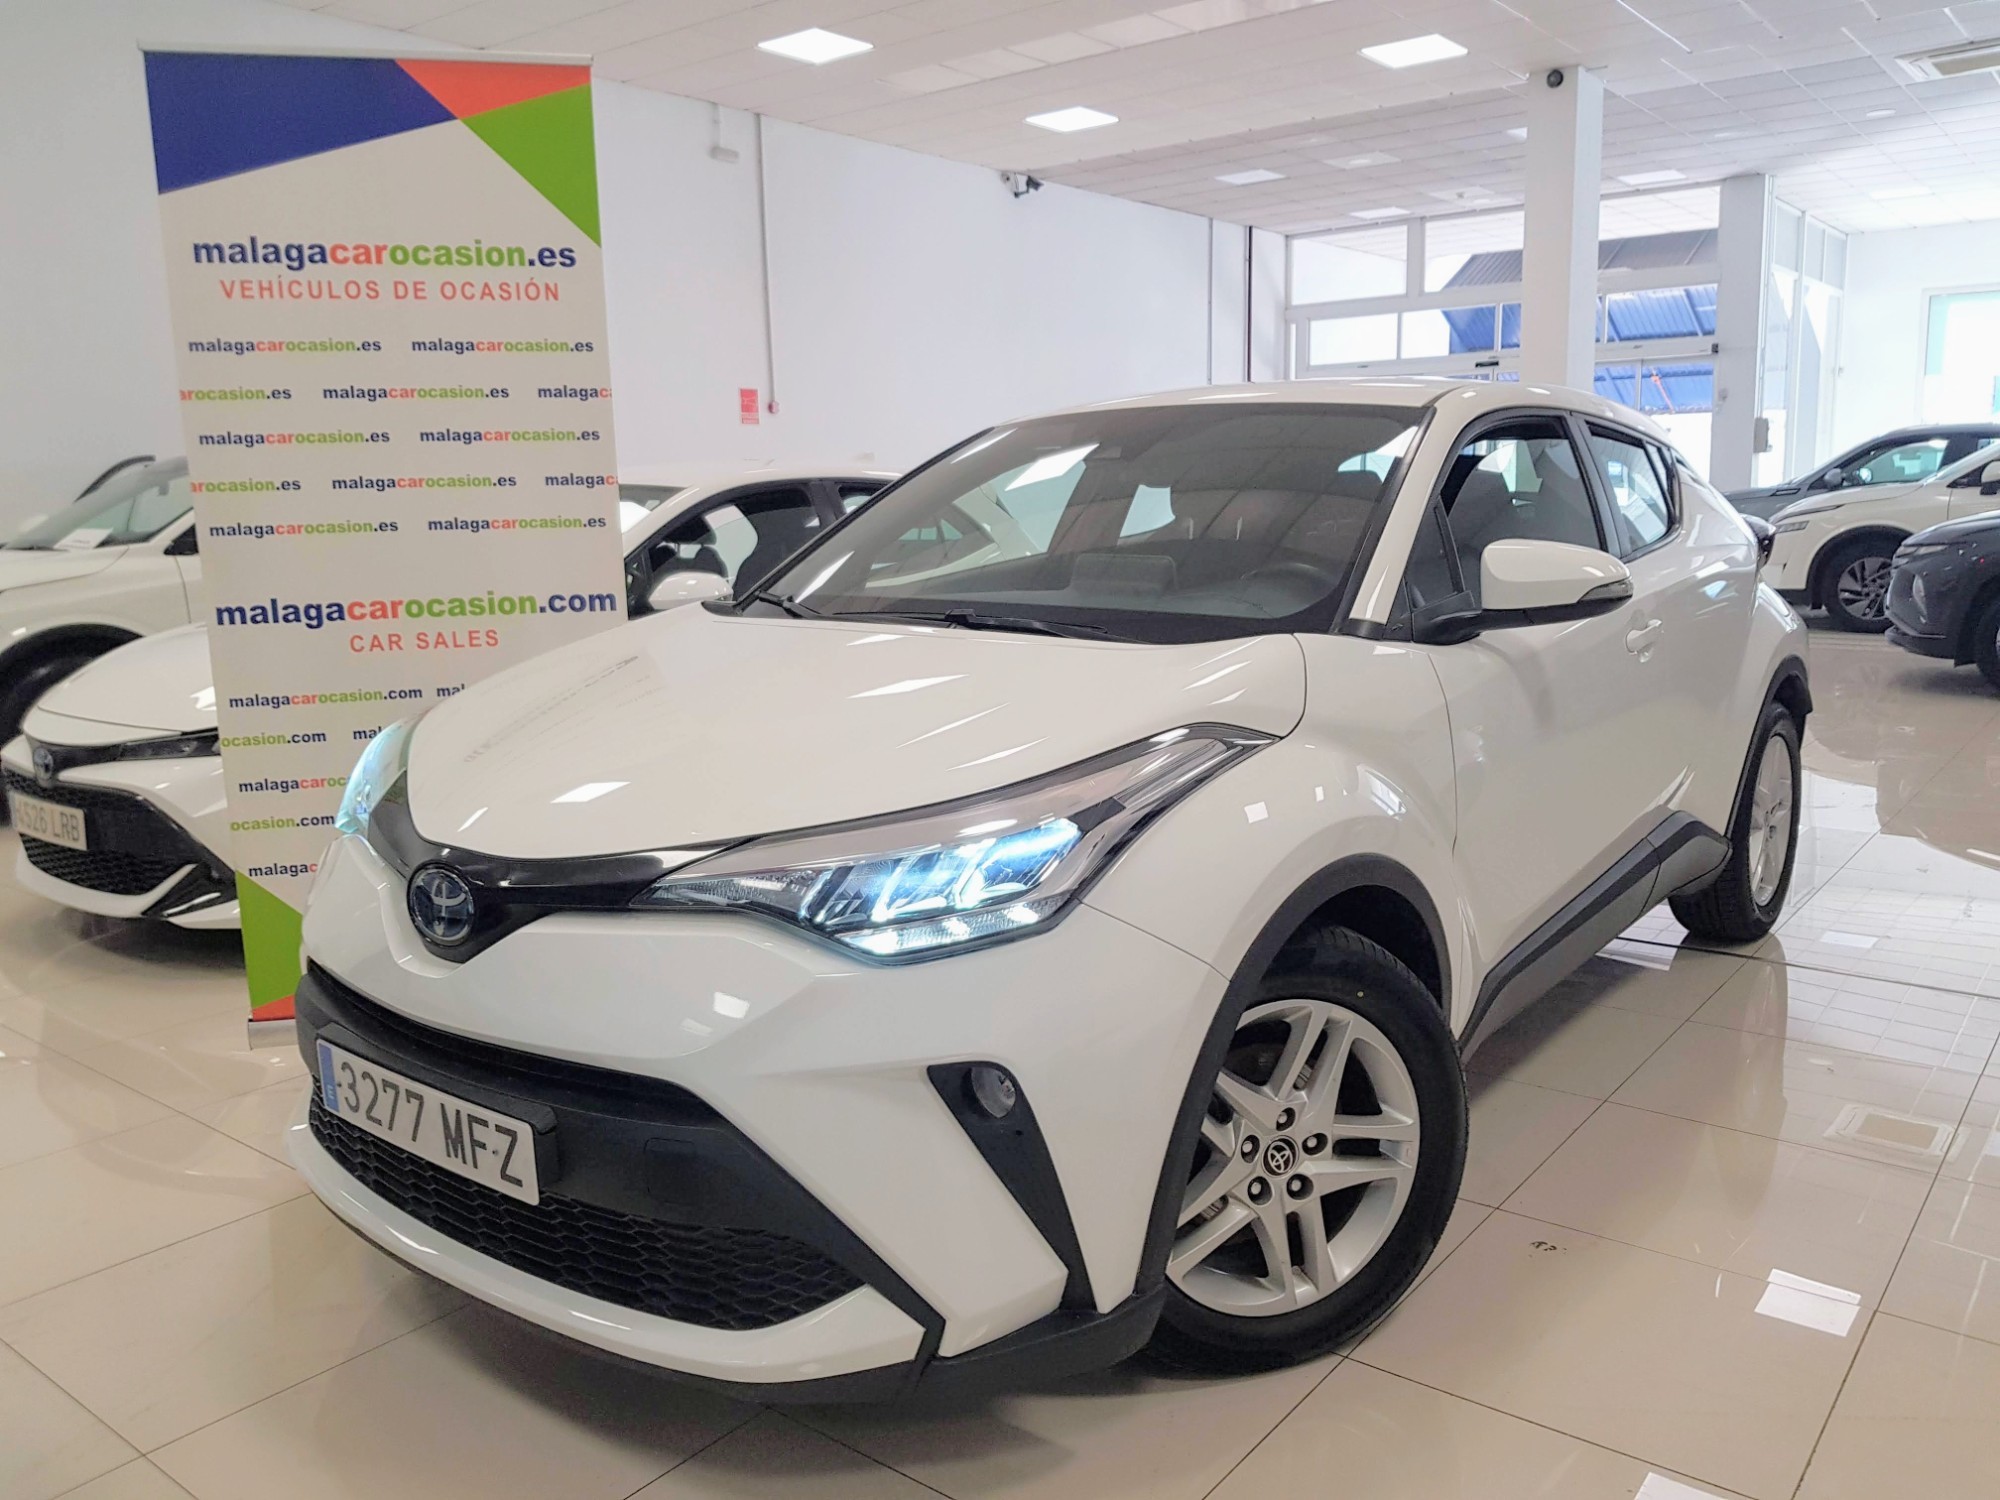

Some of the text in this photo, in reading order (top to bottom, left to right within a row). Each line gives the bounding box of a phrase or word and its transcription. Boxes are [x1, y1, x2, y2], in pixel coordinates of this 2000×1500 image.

[193, 236, 577, 271] malagacarocasion.es
[220, 275, 560, 301] VEHÍCULOS DE OCASIÓN
[188, 337, 382, 355] malagacarocasion.es
[412, 337, 594, 355] malagacarocasion.es
[323, 385, 510, 402] malagacarocasion.es
[199, 430, 390, 448] malagacarocasion.es
[420, 428, 600, 445] malagacarocasion.es
[332, 472, 517, 491] malagacarocasion.es
[545, 472, 618, 489] malagac
[209, 519, 399, 538] malagacarocasion.es
[428, 515, 606, 533] malagacarocasion.es
[215, 590, 618, 630] malagacarocasion.com
[350, 629, 500, 653] CAR SALES
[229, 686, 423, 708] malagacarocasion.com
[238, 776, 350, 793] malagacaroc
[341, 1061, 523, 1188] 3277 MFZ
